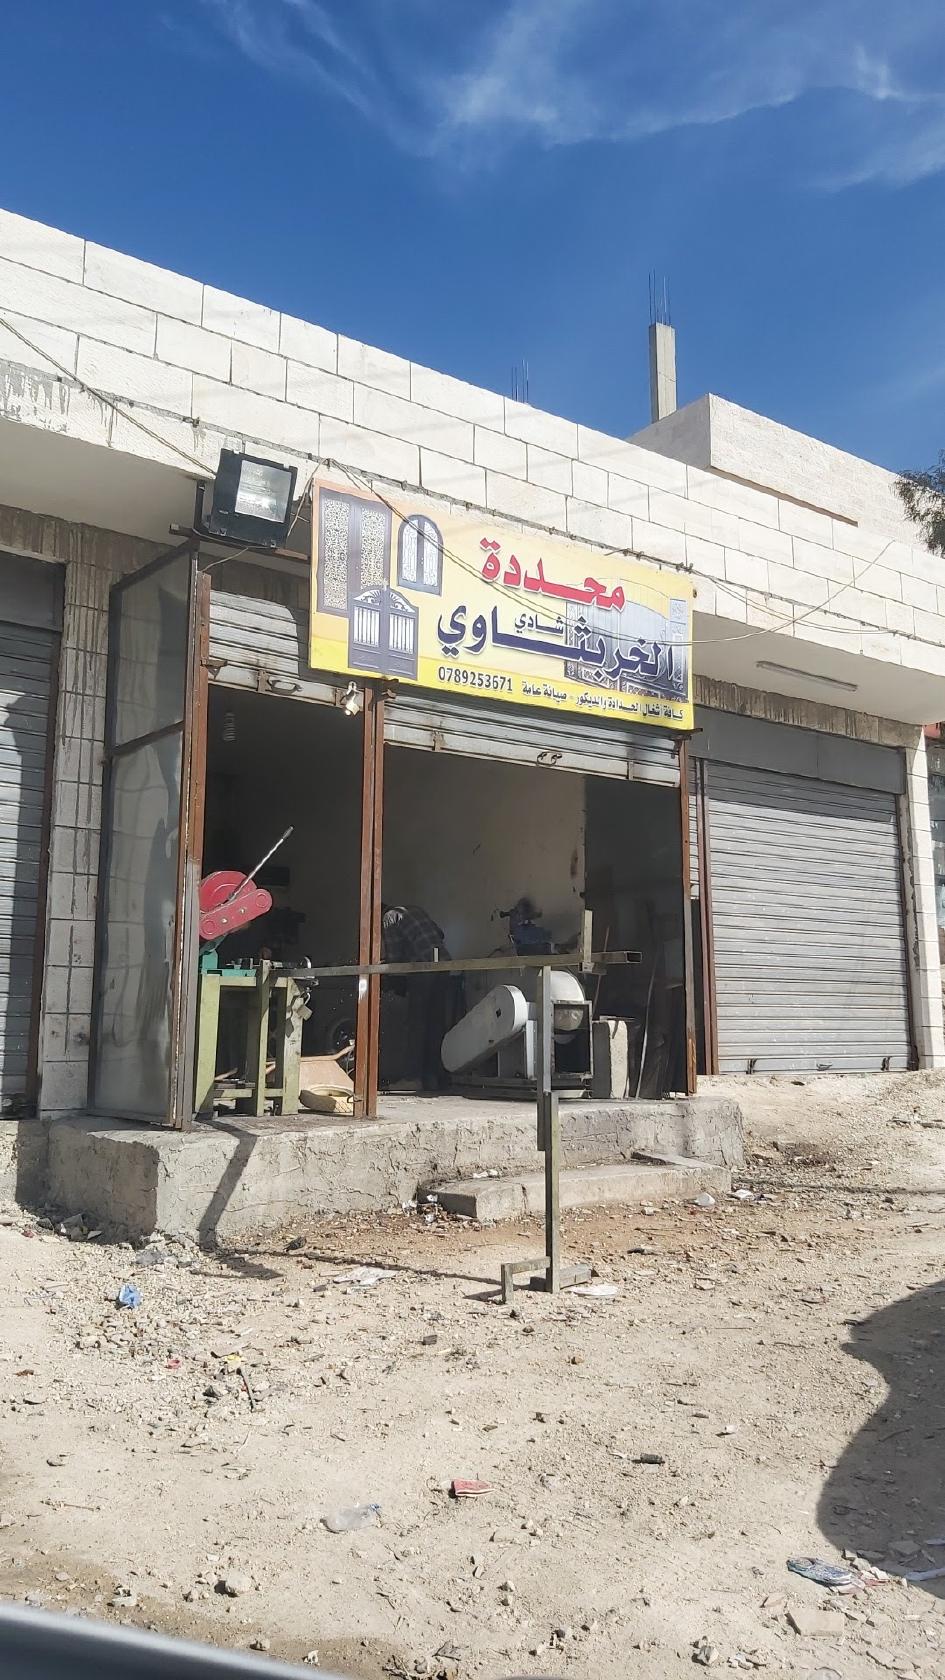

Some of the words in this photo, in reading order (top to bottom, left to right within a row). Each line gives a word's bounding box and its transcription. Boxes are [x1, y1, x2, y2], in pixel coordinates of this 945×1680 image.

[480, 538, 626, 611] محددة
[514, 613, 564, 635] شادي
[438, 666, 513, 692] 0789253671
[521, 681, 542, 696] عامة
[542, 684, 567, 703] صيانة
[576, 692, 607, 710] والديكور
[608, 696, 642, 713] الحدادة
[664, 704, 684, 719] كافة
